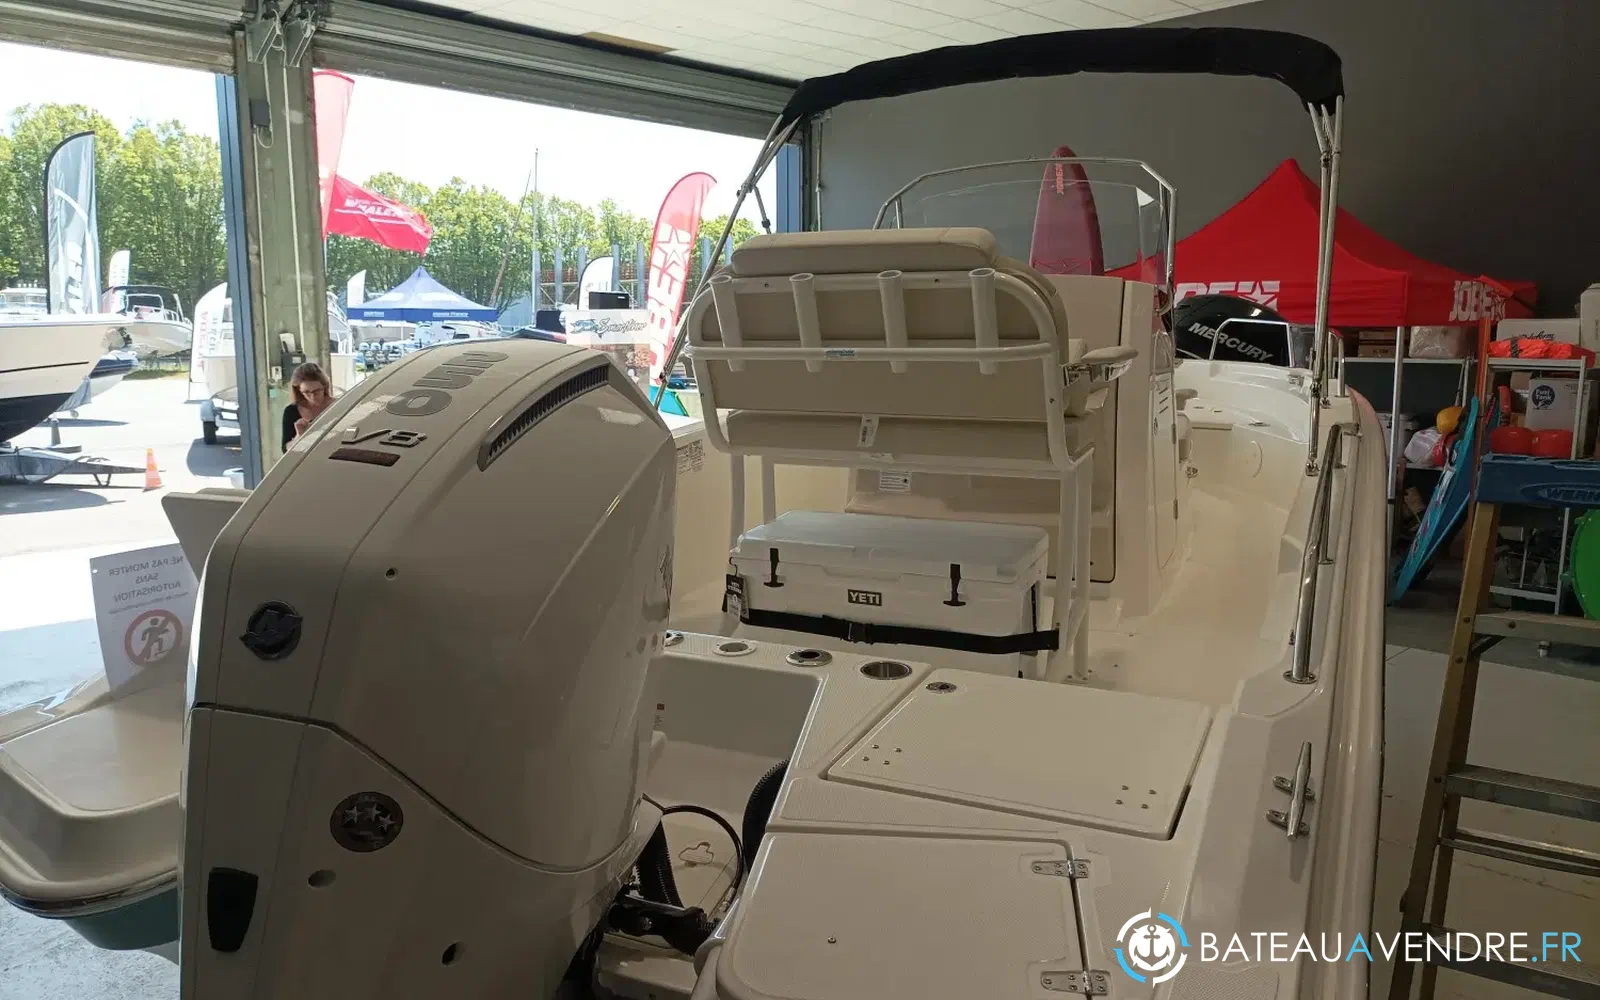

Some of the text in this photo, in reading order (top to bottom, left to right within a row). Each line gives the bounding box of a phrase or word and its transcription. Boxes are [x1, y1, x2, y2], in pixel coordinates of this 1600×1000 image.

[1449, 280, 1493, 322] JOBE
[1188, 322, 1274, 361] MERCURY
[341, 426, 428, 449] V8
[849, 591, 880, 605] YETI
